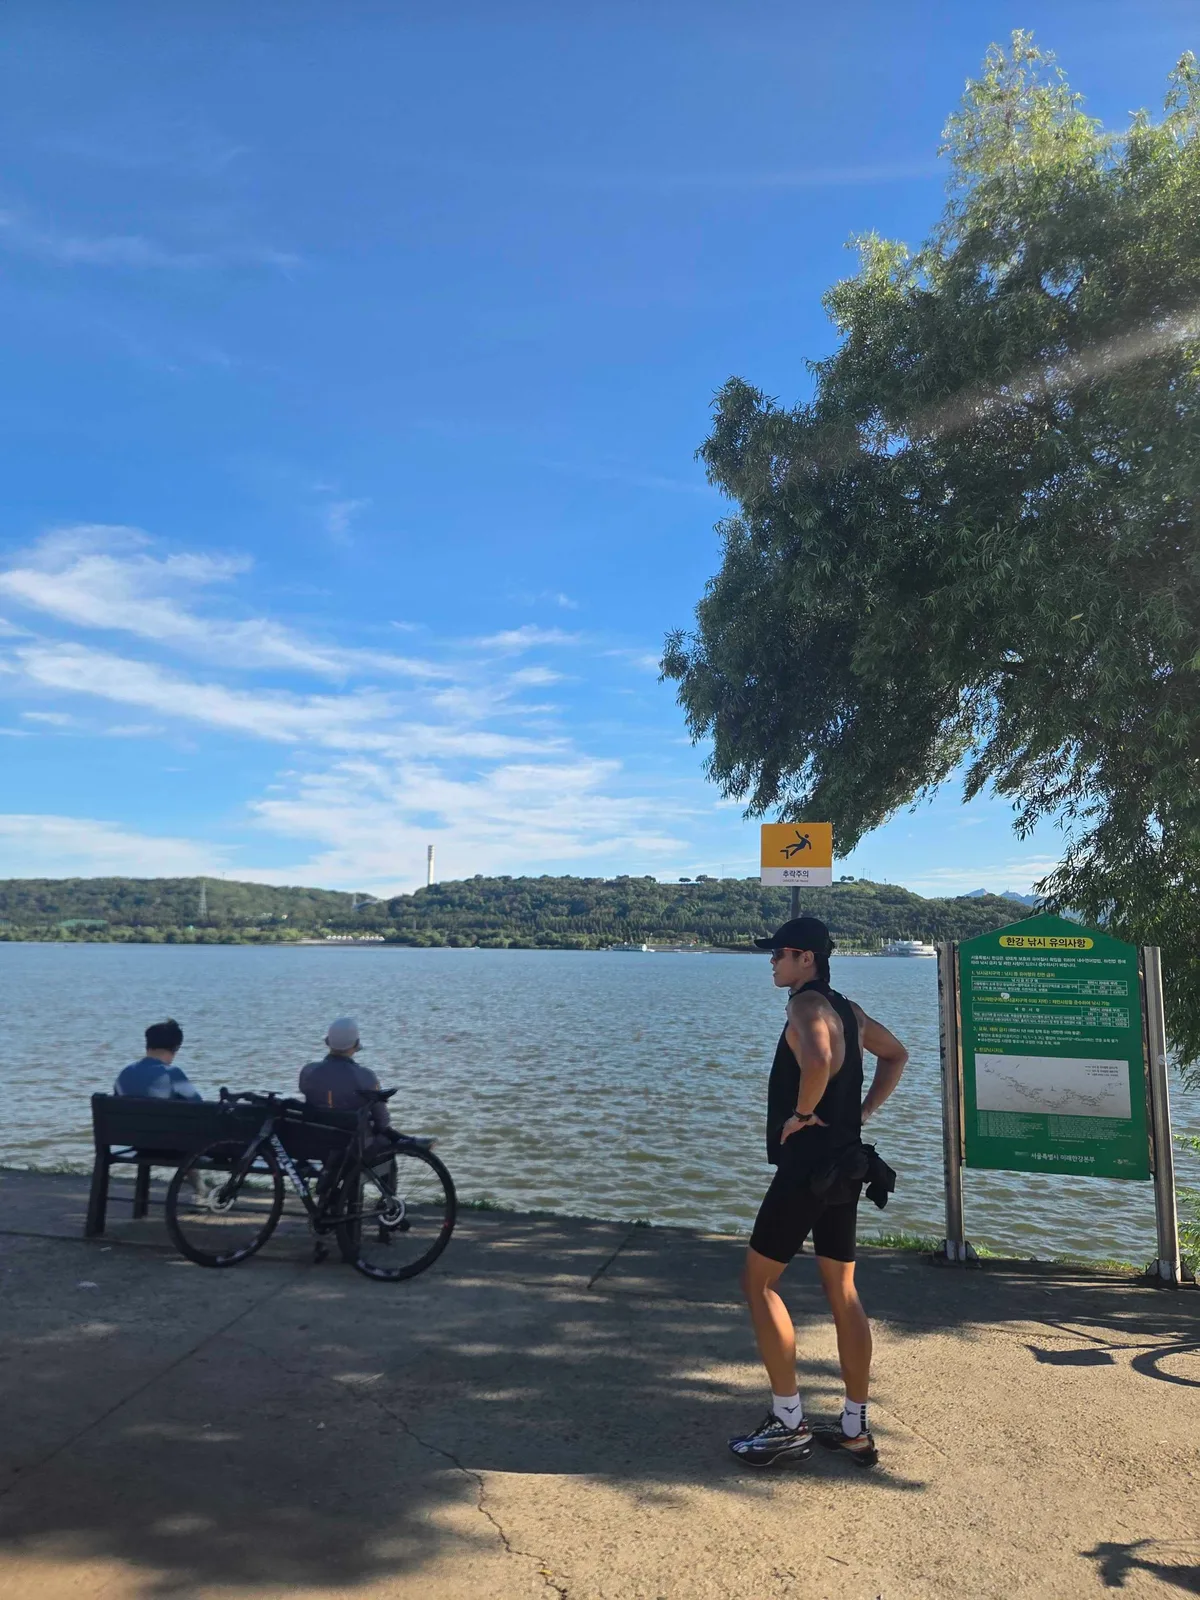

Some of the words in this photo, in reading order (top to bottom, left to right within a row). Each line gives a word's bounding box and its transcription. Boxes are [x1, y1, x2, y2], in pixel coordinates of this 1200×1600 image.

[783, 870, 809, 878] 추락주의
[1006, 937, 1025, 947] 한강
[1027, 937, 1046, 947] 낚시
[1049, 937, 1086, 949] 유의사항
[1030, 1152, 1059, 1160] 서울특별시
[1060, 1154, 1096, 1163] 미래한강본부
